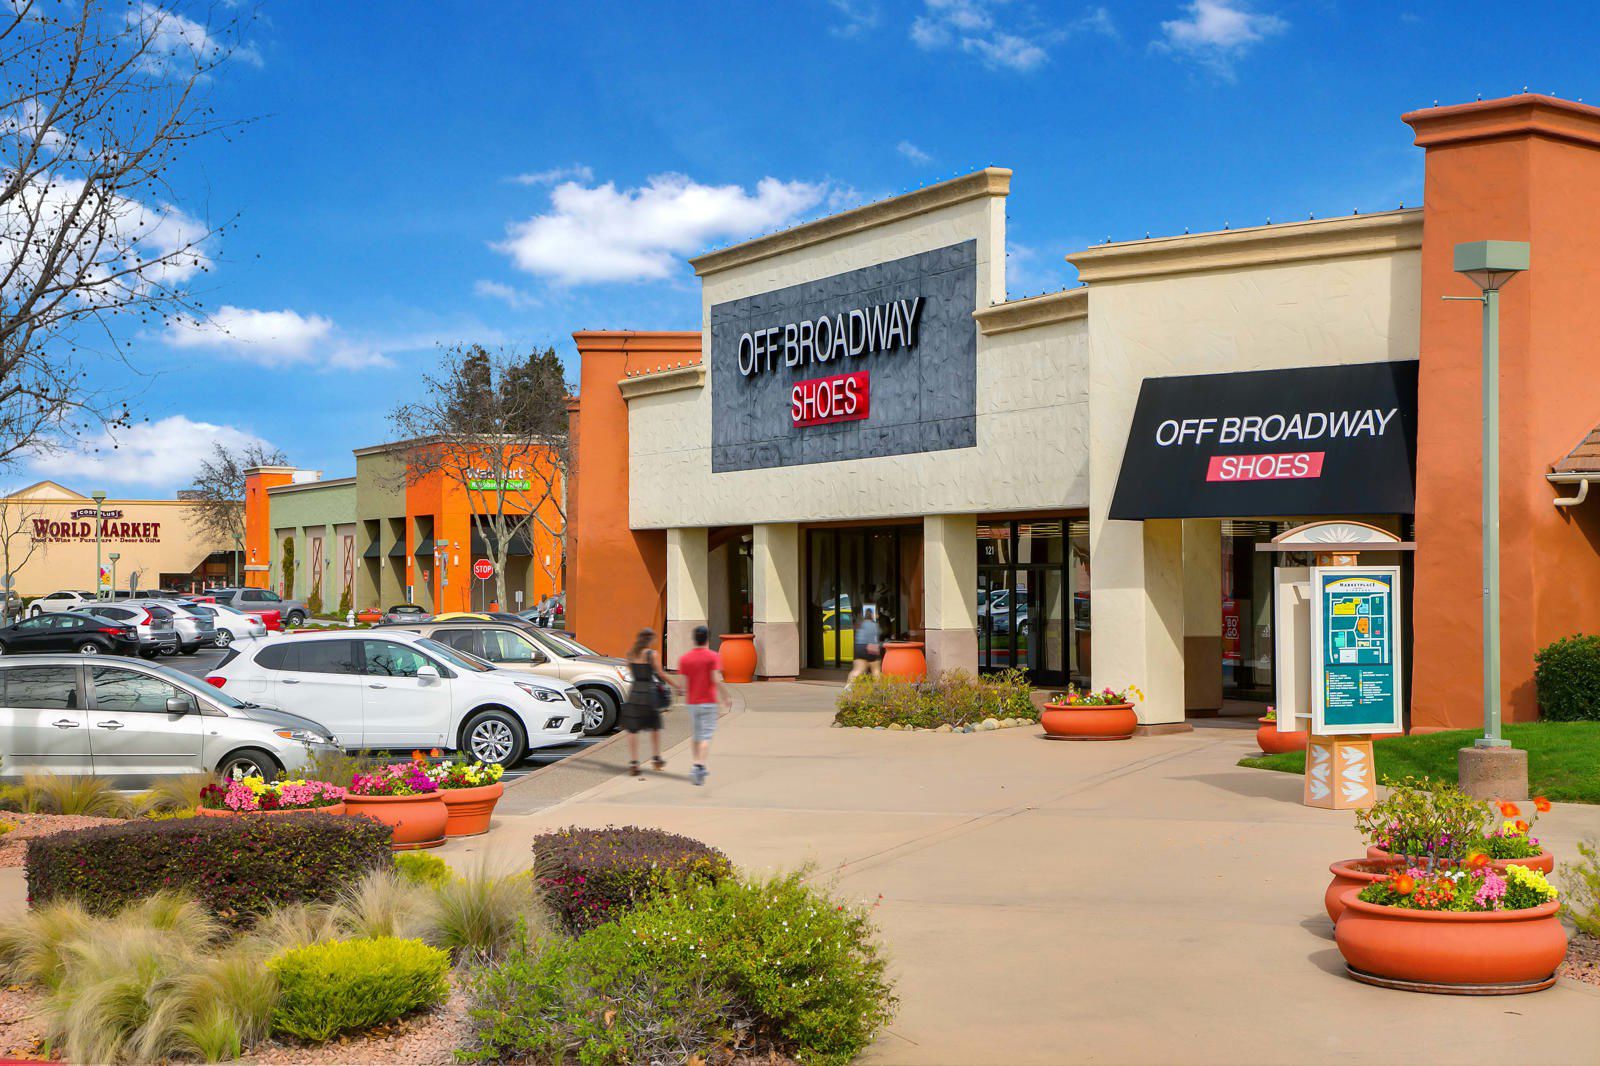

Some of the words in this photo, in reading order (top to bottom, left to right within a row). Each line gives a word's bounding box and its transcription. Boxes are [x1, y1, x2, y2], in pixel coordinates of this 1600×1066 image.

[738, 327, 780, 376] OFF
[785, 297, 920, 367] BROADWAY
[791, 377, 857, 422] SHOES
[1156, 418, 1218, 447] OFF
[1219, 408, 1398, 444] BROADWAY
[1219, 454, 1311, 480] SHOES
[32, 519, 92, 538] WORLD
[95, 519, 160, 538] MARKET
[985, 545, 994, 555] 121
[475, 565, 492, 573] STOP
